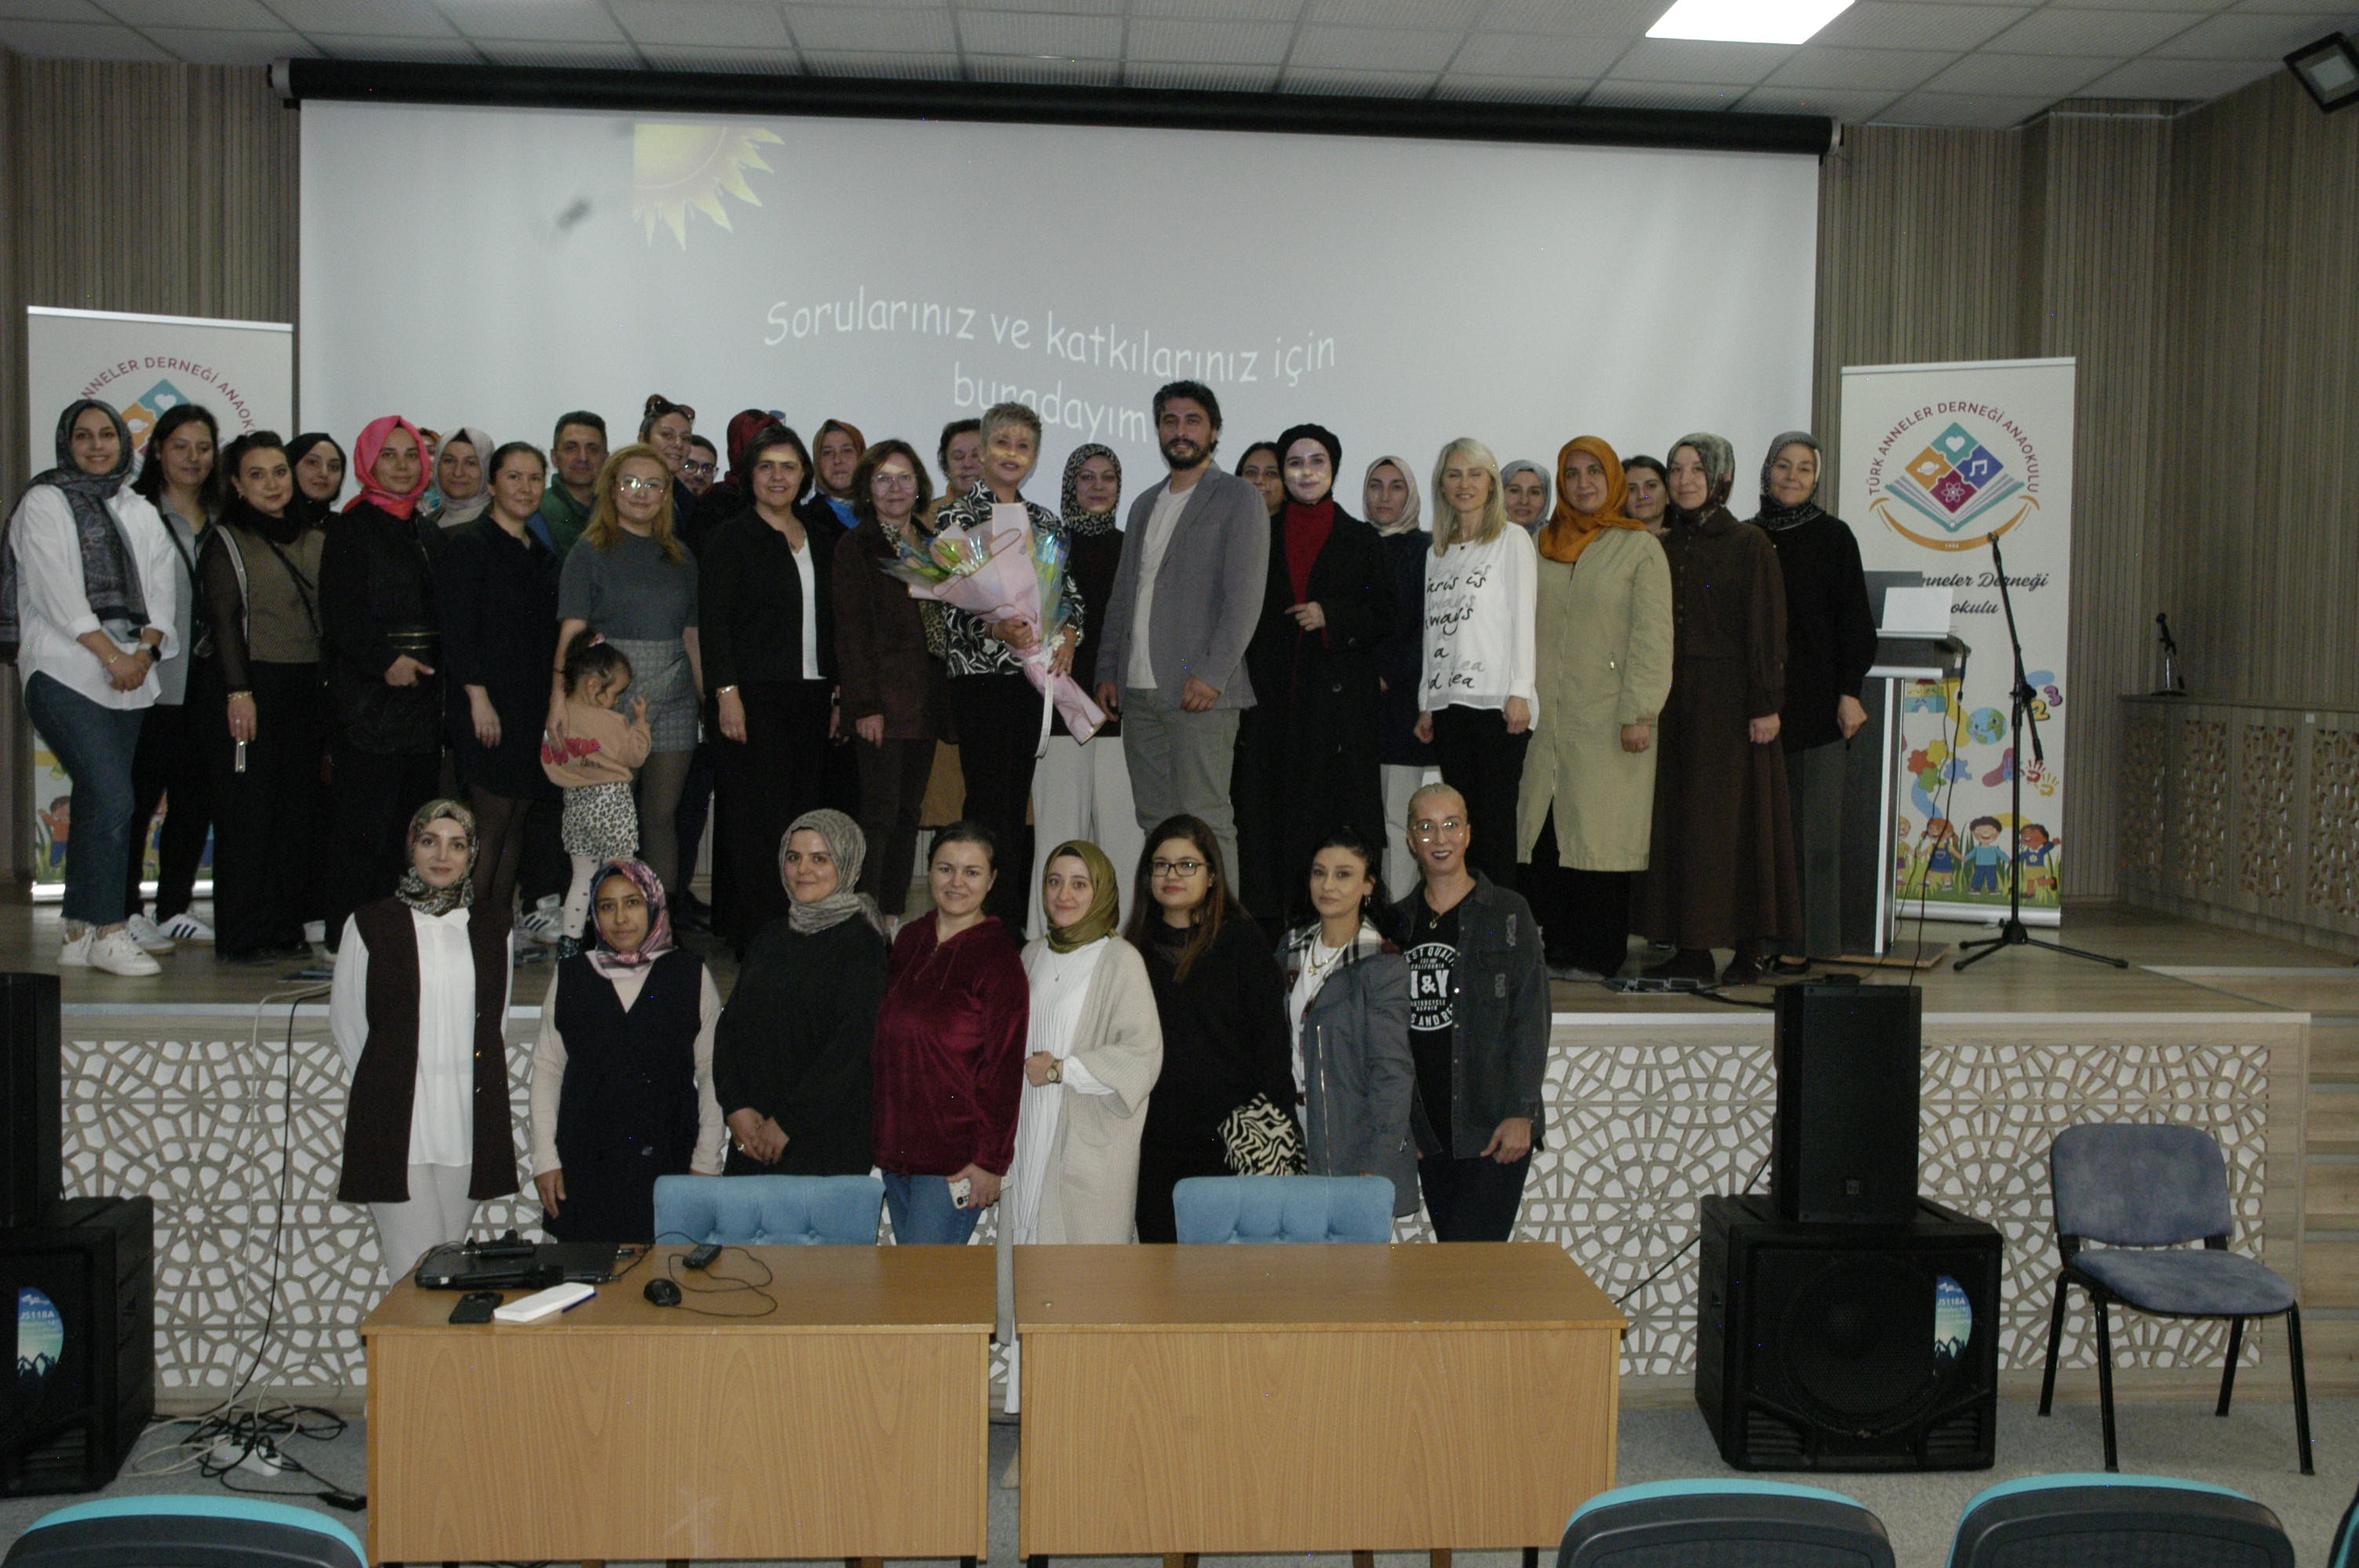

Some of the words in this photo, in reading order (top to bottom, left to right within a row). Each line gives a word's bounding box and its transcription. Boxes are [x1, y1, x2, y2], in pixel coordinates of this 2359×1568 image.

[764, 285, 976, 346] Sorularınız
[990, 313, 1031, 350] ve
[1046, 310, 1259, 383] katkılarınız
[1274, 329, 1335, 387] için
[80, 359, 140, 401] NNELER
[144, 357, 220, 384] DERNEĞİ
[216, 382, 256, 437] ANAOK
[1869, 458, 1884, 495] TÜRK
[1879, 406, 1934, 456] ANNELER
[1937, 401, 2005, 423] DERNEĞİ
[2002, 419, 2040, 493] ANAOKULU
[1922, 573, 1973, 588] nneler
[1950, 600, 1999, 614] okulu
[2043, 685, 2063, 707] 3
[1405, 947, 1424, 963] EST
[1427, 946, 1455, 966] QUALI
[1418, 1014, 1441, 1027] AND
